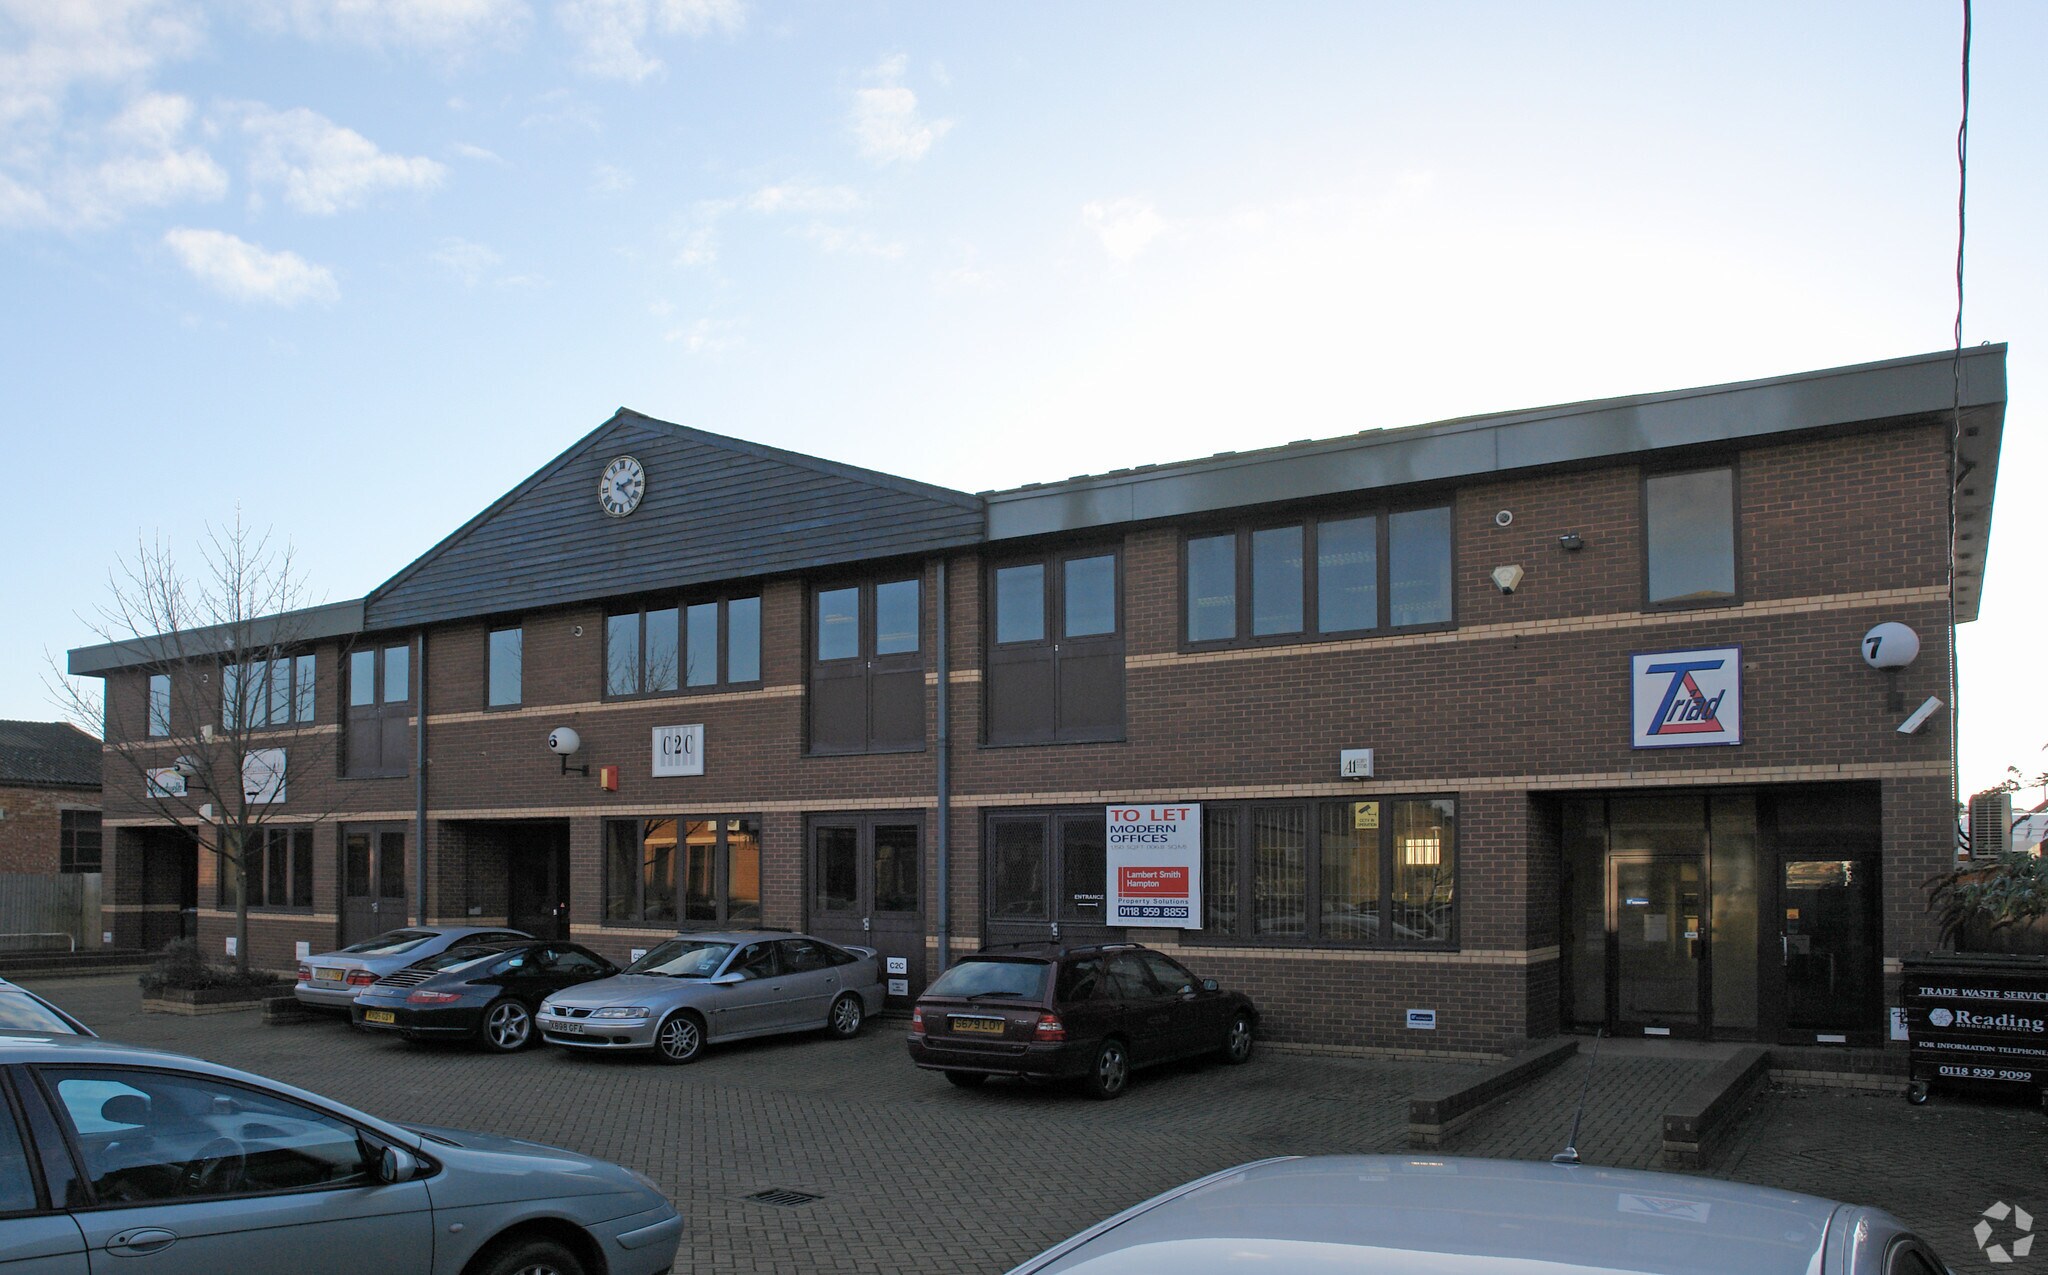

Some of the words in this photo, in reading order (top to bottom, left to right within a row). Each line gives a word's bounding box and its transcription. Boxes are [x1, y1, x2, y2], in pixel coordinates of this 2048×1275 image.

[1866, 636, 1882, 659] 7
[1645, 660, 1726, 735] Triad
[549, 734, 557, 748] 6
[663, 735, 693, 755] C2C
[1110, 809, 1140, 822] TO
[1150, 808, 1190, 821] LET
[1110, 824, 1176, 833] MODERN
[1110, 834, 1168, 843] OFFICES
[1126, 870, 1157, 878] Lambert
[1159, 870, 1181, 878] Smith
[1126, 880, 1159, 888] Hampton
[1120, 906, 1140, 916] 0118
[1142, 906, 1160, 916] 959
[1163, 907, 1188, 917] 8855
[1919, 987, 1957, 996] TRADE
[1962, 989, 1999, 998] WASTE
[955, 1019, 980, 1029] S679
[1955, 1010, 2044, 1033] Reading
[569, 1024, 584, 1033] GFA
[1937, 1043, 1996, 1052] INFORMATION
[1939, 1066, 1968, 1075] 0118
[1973, 1068, 1994, 1077] 939
[1999, 1070, 2031, 1080] 9099
